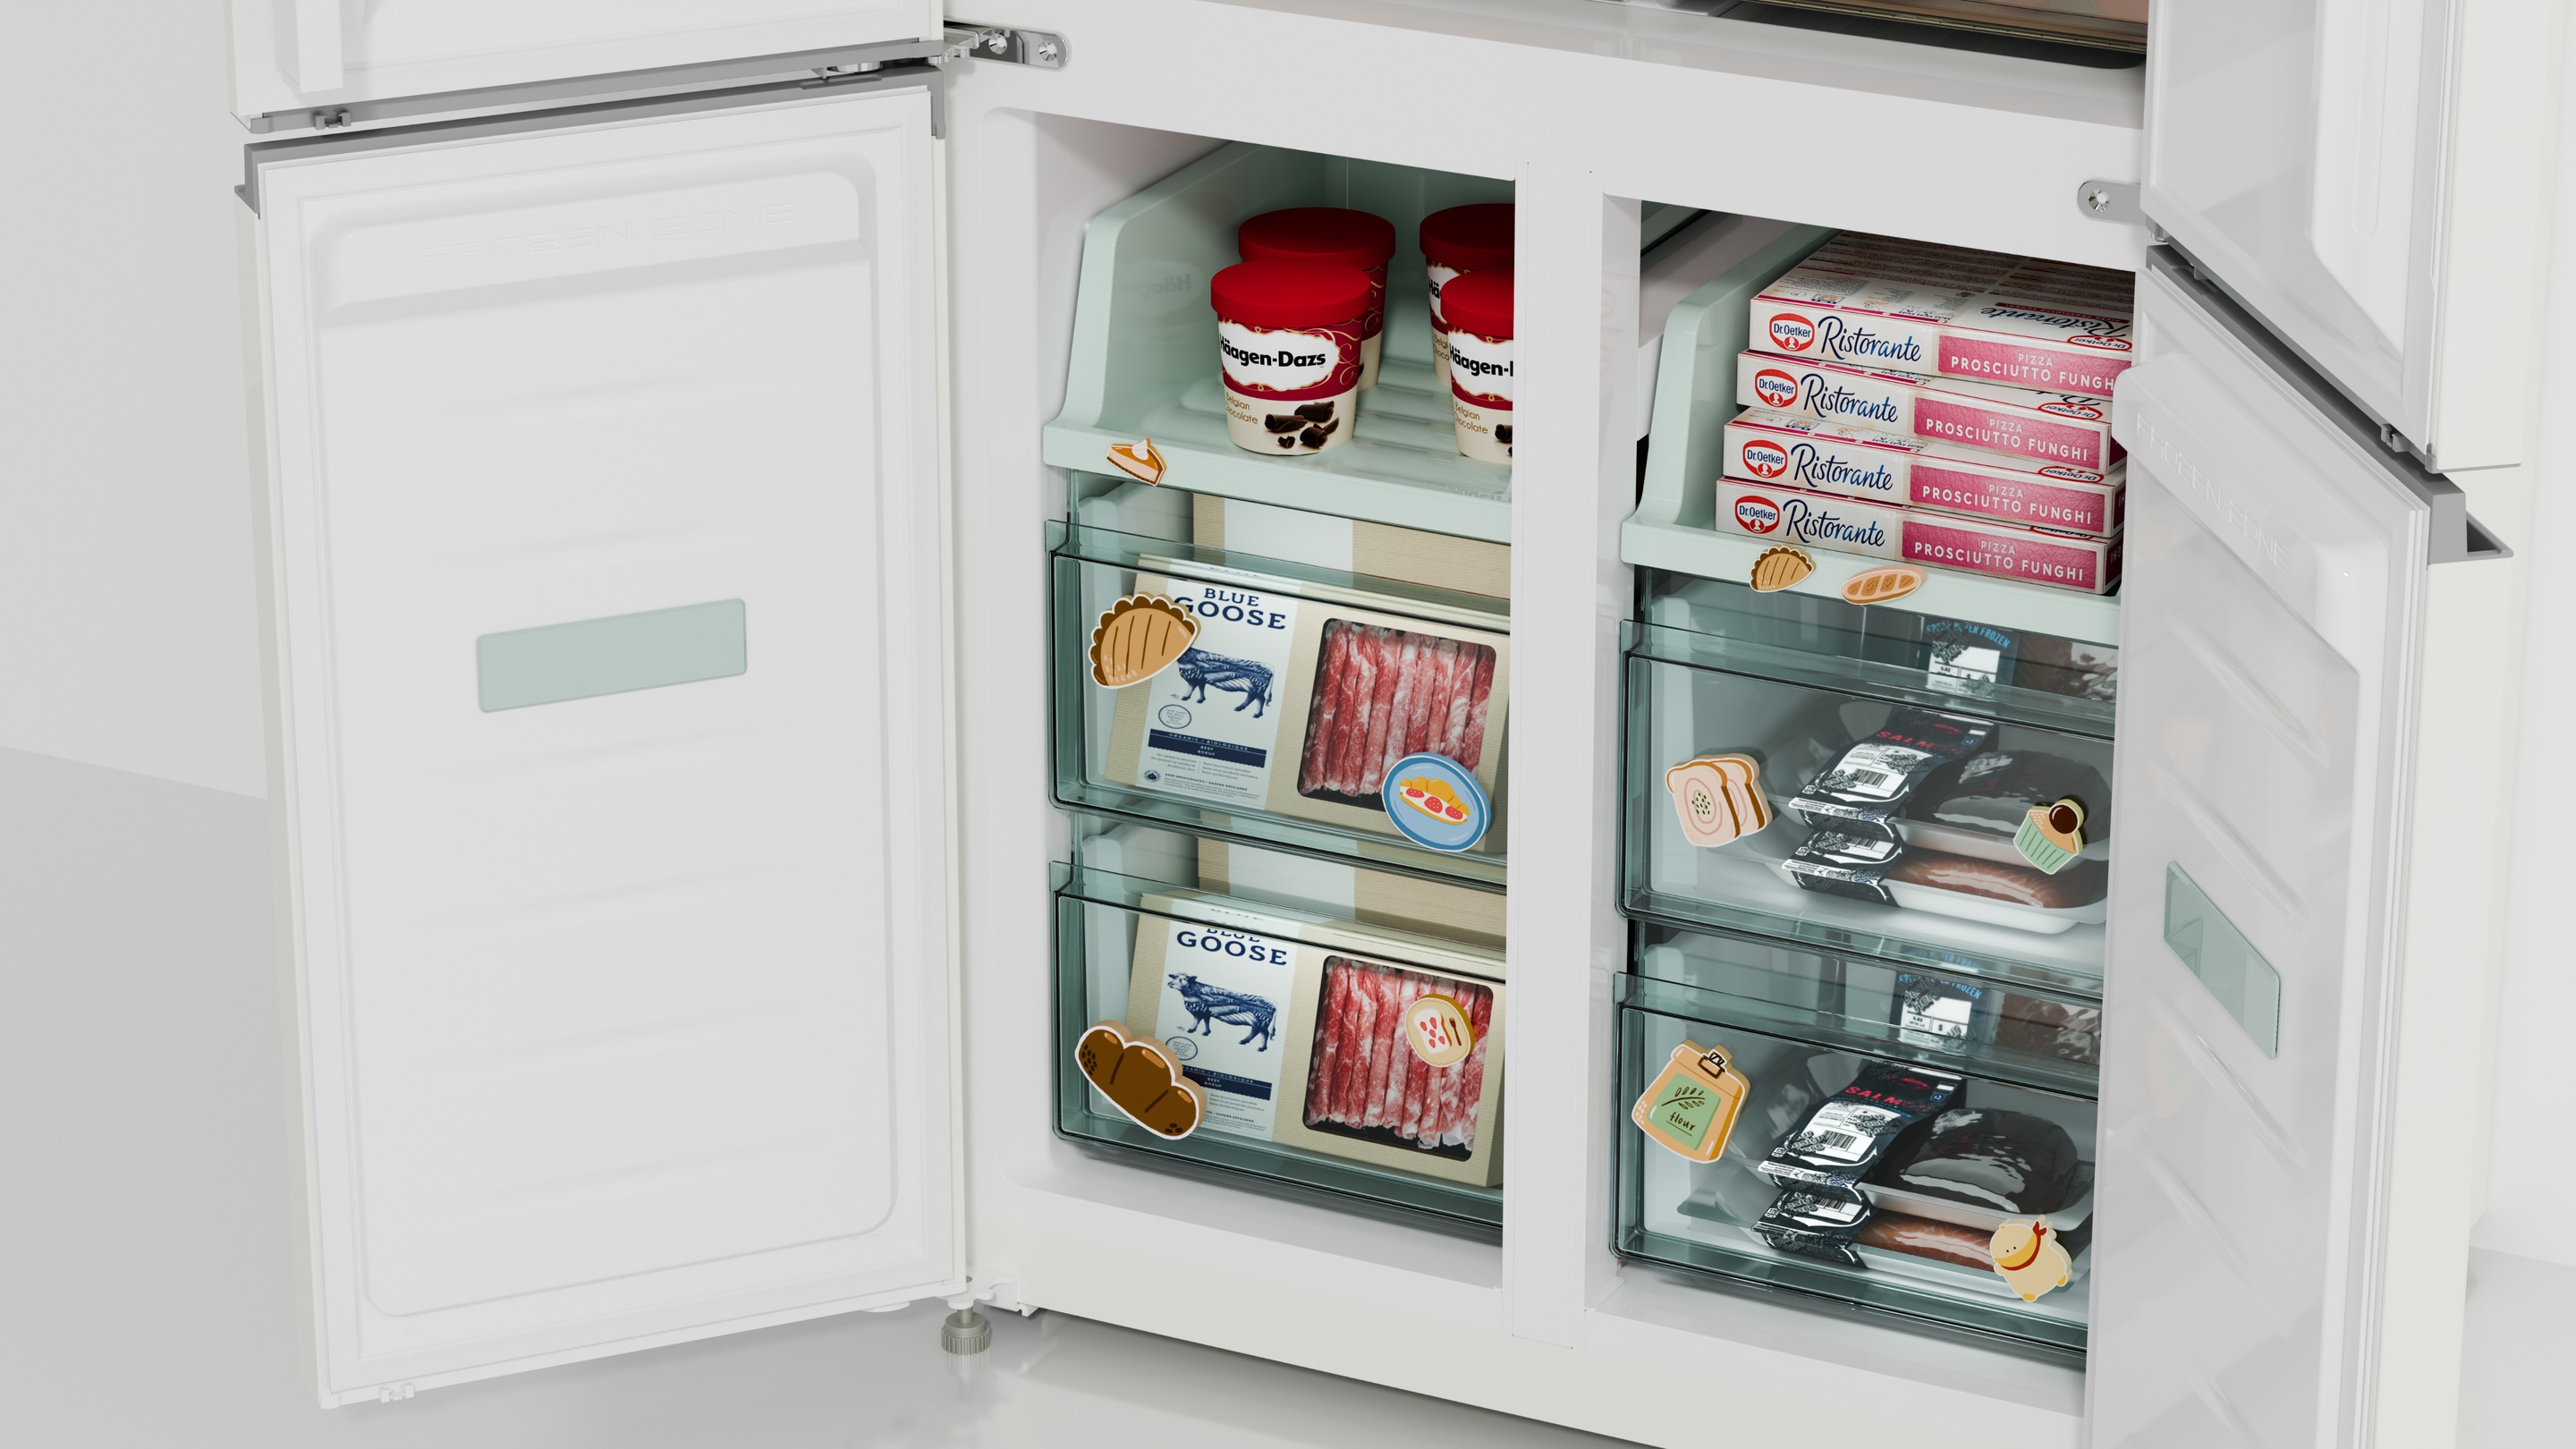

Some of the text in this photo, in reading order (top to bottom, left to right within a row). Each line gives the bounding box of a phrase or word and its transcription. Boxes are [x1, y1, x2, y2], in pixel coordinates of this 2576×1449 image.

[1980, 307, 2131, 338] Ristorante
[1219, 334, 1326, 368] Häagen-Dazs
[1434, 334, 1448, 350] Belgi
[1818, 316, 1922, 362] Ristorante
[1449, 343, 1514, 377] Häagen-
[2018, 353, 2054, 368] PIZZA
[1951, 356, 2114, 392] PROSCIUTTO FUNGH
[1226, 392, 1250, 411] Belgian
[1801, 373, 1899, 422] Ristorante
[1455, 402, 1480, 421] Belgian
[1989, 418, 2022, 433] PIZZA
[1927, 418, 2088, 461] PROSCIUTTO FUNGHI
[1791, 443, 1894, 490] Ristorante
[1988, 484, 2023, 498] PIZZA
[1922, 486, 2091, 524] PROSCIUTTO FUNGHI
[1783, 499, 1885, 547] Ristorante
[1914, 541, 2083, 580] PROSCIUTTO FUNGHI
[1980, 540, 2016, 555] PIZZA
[1204, 588, 1259, 606] BLUE
[1979, 627, 2011, 648] FROZEN
[1169, 733, 1199, 741] ORGANIC
[1207, 740, 1249, 750] BIOLOGIQUE
[1177, 931, 1287, 965] GOOSE
[1182, 1065, 1205, 1073] GANIC
[1213, 1072, 1254, 1083] BIOLOGIQUE
[1669, 1112, 1696, 1131] flour
